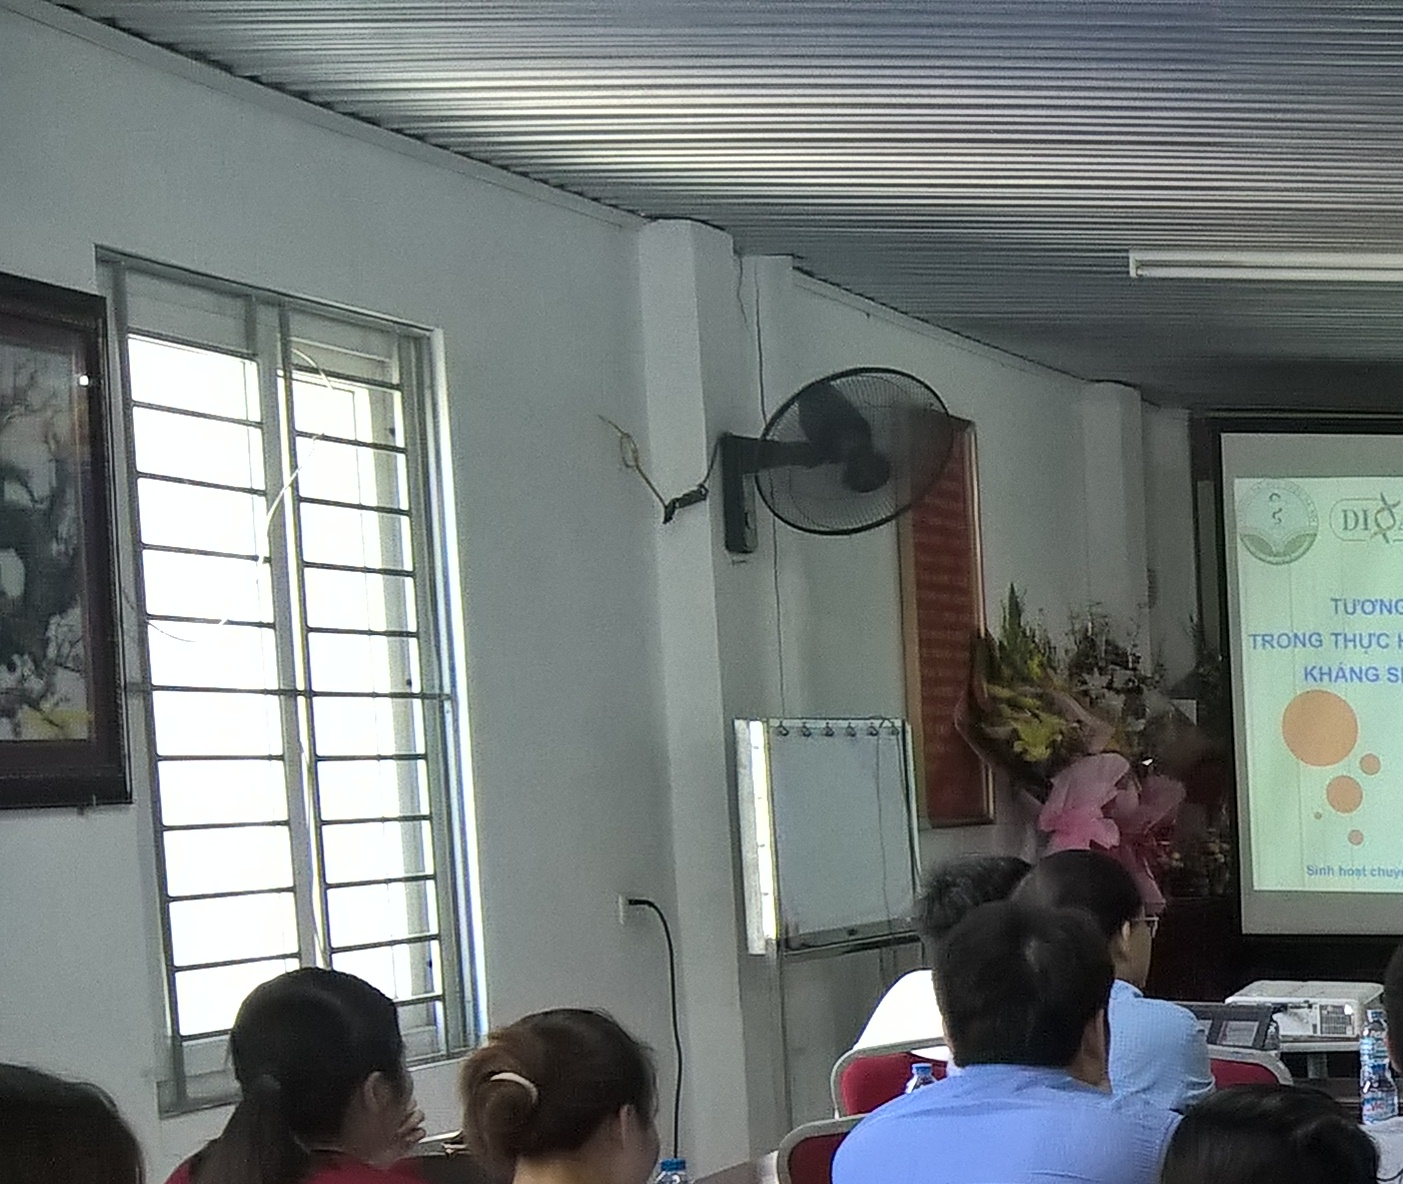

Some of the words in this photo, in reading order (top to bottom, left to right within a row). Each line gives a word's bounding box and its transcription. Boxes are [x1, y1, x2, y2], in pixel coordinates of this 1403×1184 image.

[1248, 632, 1324, 651] TRONG
[1330, 631, 1390, 655] THỰC
[1304, 662, 1380, 684] KHÁNG
[1306, 865, 1335, 876] Sinh
